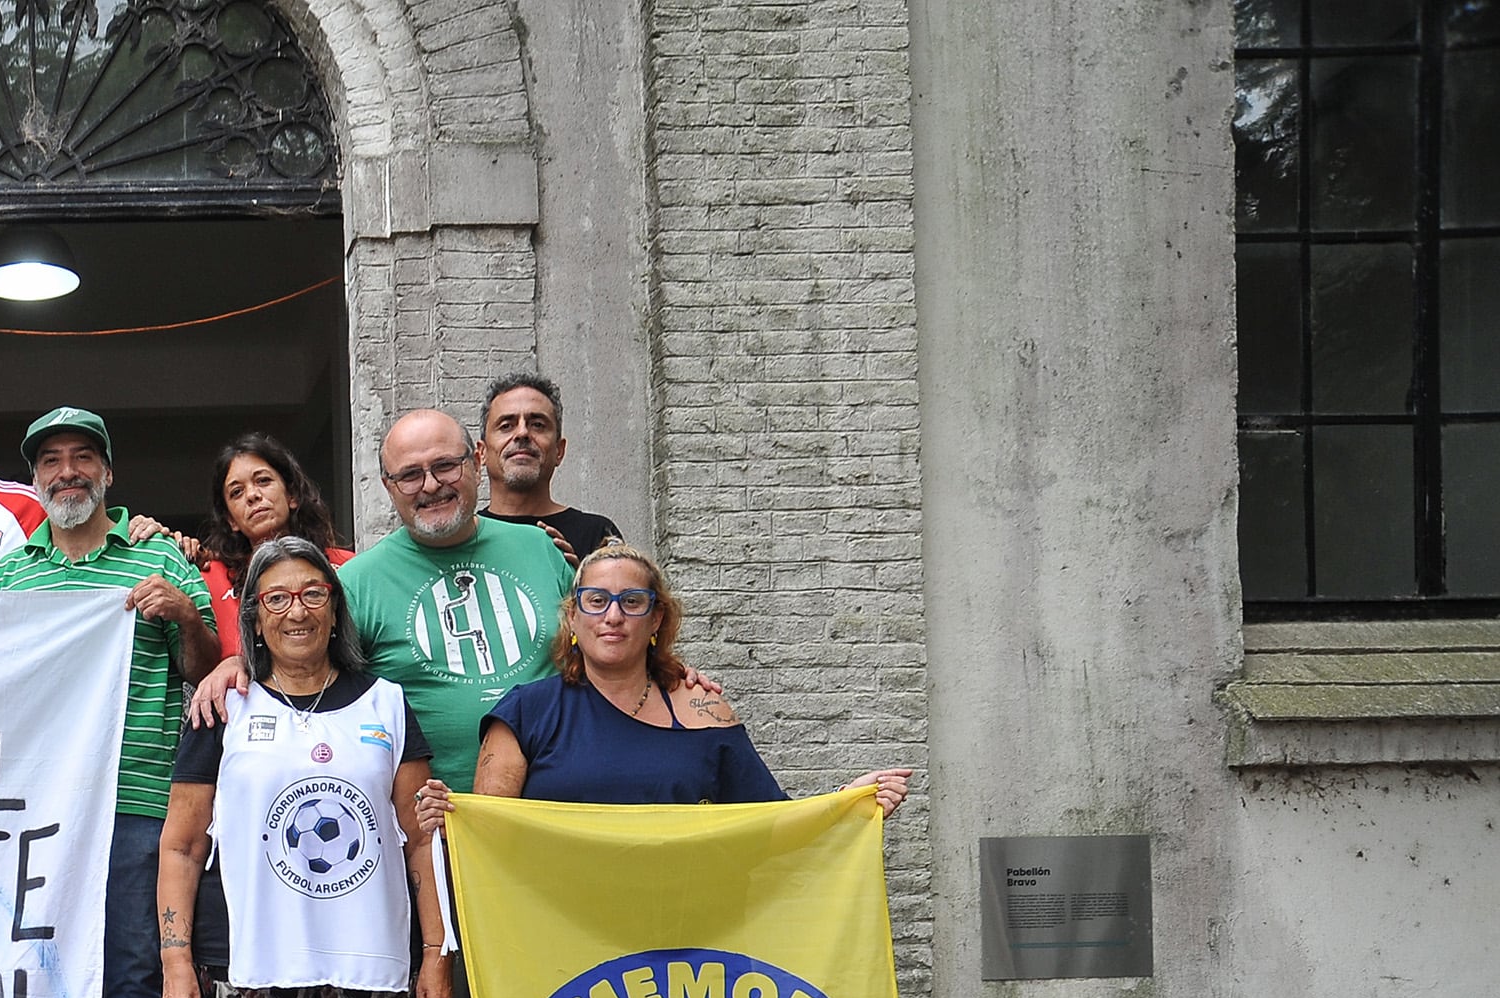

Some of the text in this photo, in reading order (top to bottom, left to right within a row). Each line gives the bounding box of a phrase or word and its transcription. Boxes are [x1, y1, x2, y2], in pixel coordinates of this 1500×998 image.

[269, 782, 377, 832] COORDINADORA DE DDHH
[276, 858, 374, 894] FÚTBOL ARGENTINO
[1006, 866, 1051, 877] Pabellón
[1007, 878, 1037, 887] Bravo
